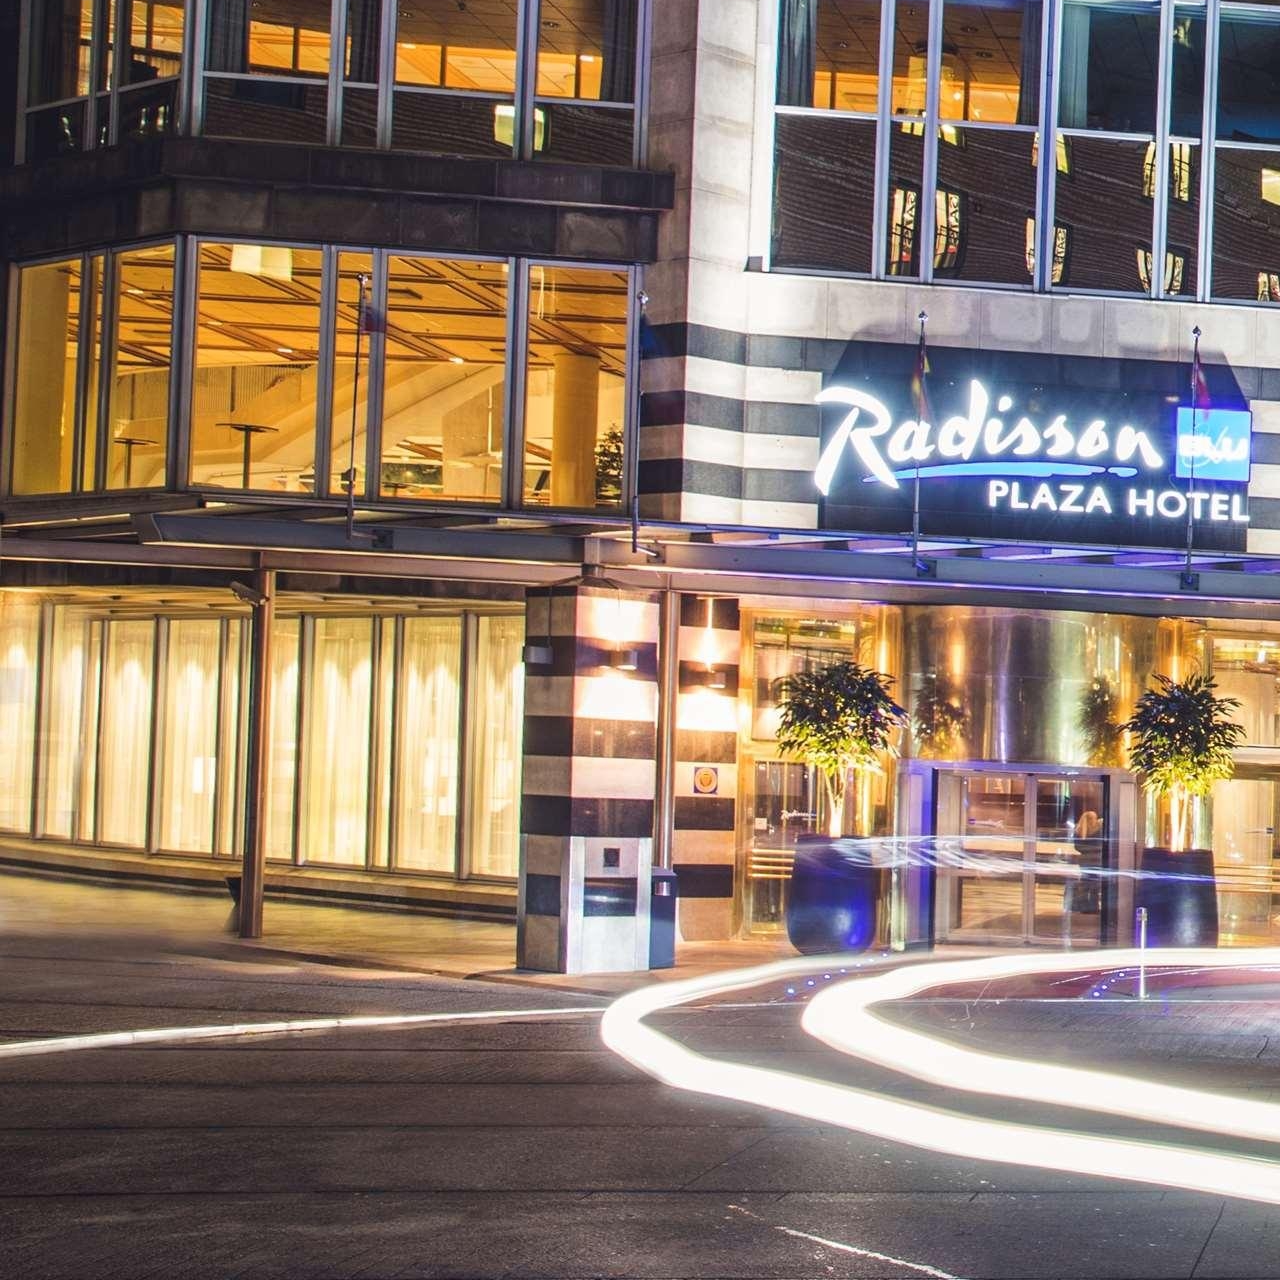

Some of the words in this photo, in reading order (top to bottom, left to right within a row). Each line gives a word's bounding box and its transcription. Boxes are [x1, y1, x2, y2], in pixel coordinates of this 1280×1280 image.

[813, 379, 1164, 496] Radisson
[988, 479, 1113, 514] PLAZA
[1128, 488, 1251, 522] HOTEL
